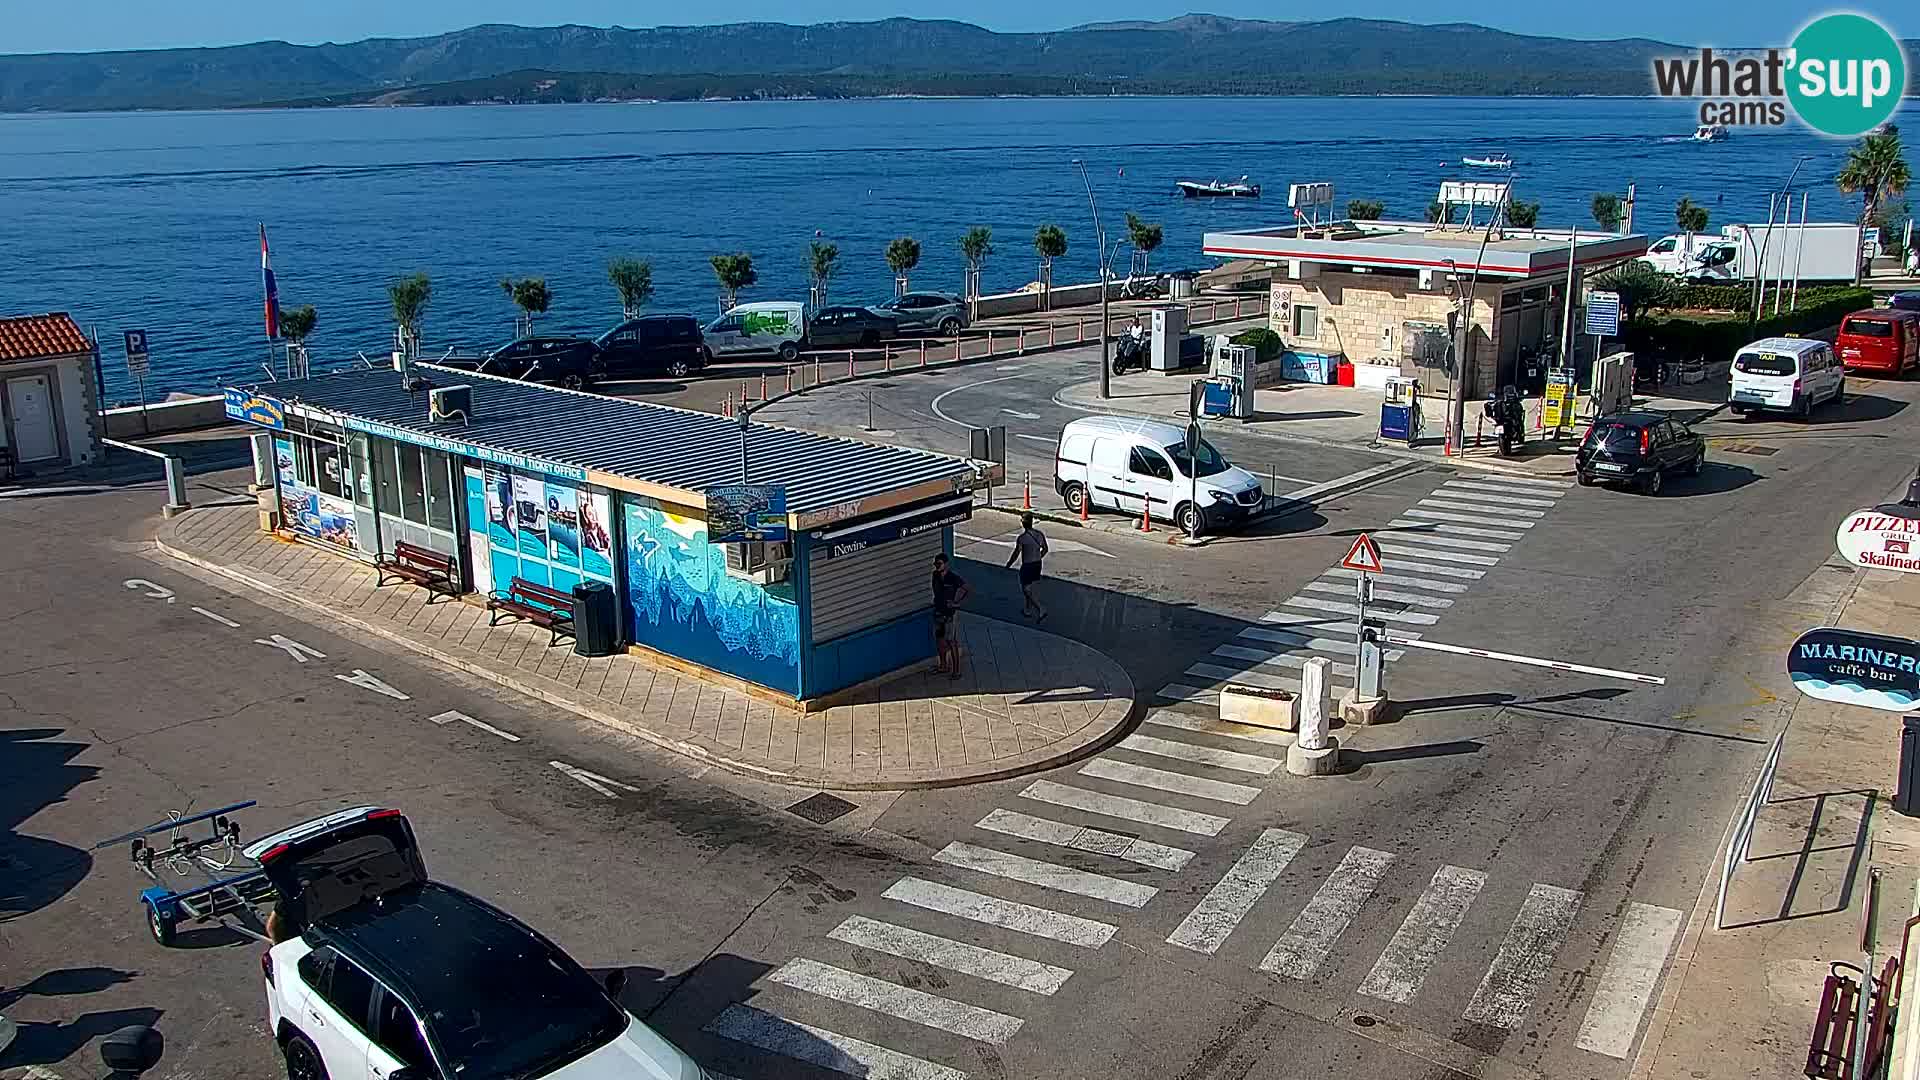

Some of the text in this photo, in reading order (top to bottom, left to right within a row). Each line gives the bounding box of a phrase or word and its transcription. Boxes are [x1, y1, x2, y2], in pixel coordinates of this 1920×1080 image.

[129, 334, 142, 352] P
[436, 438, 467, 453] POSTAJA
[477, 447, 582, 478] BUS STATION TICKET OFFICE
[1848, 517, 1920, 535] PIZZE
[1881, 532, 1916, 542] GRILL
[1829, 664, 1897, 681] caffe bar
